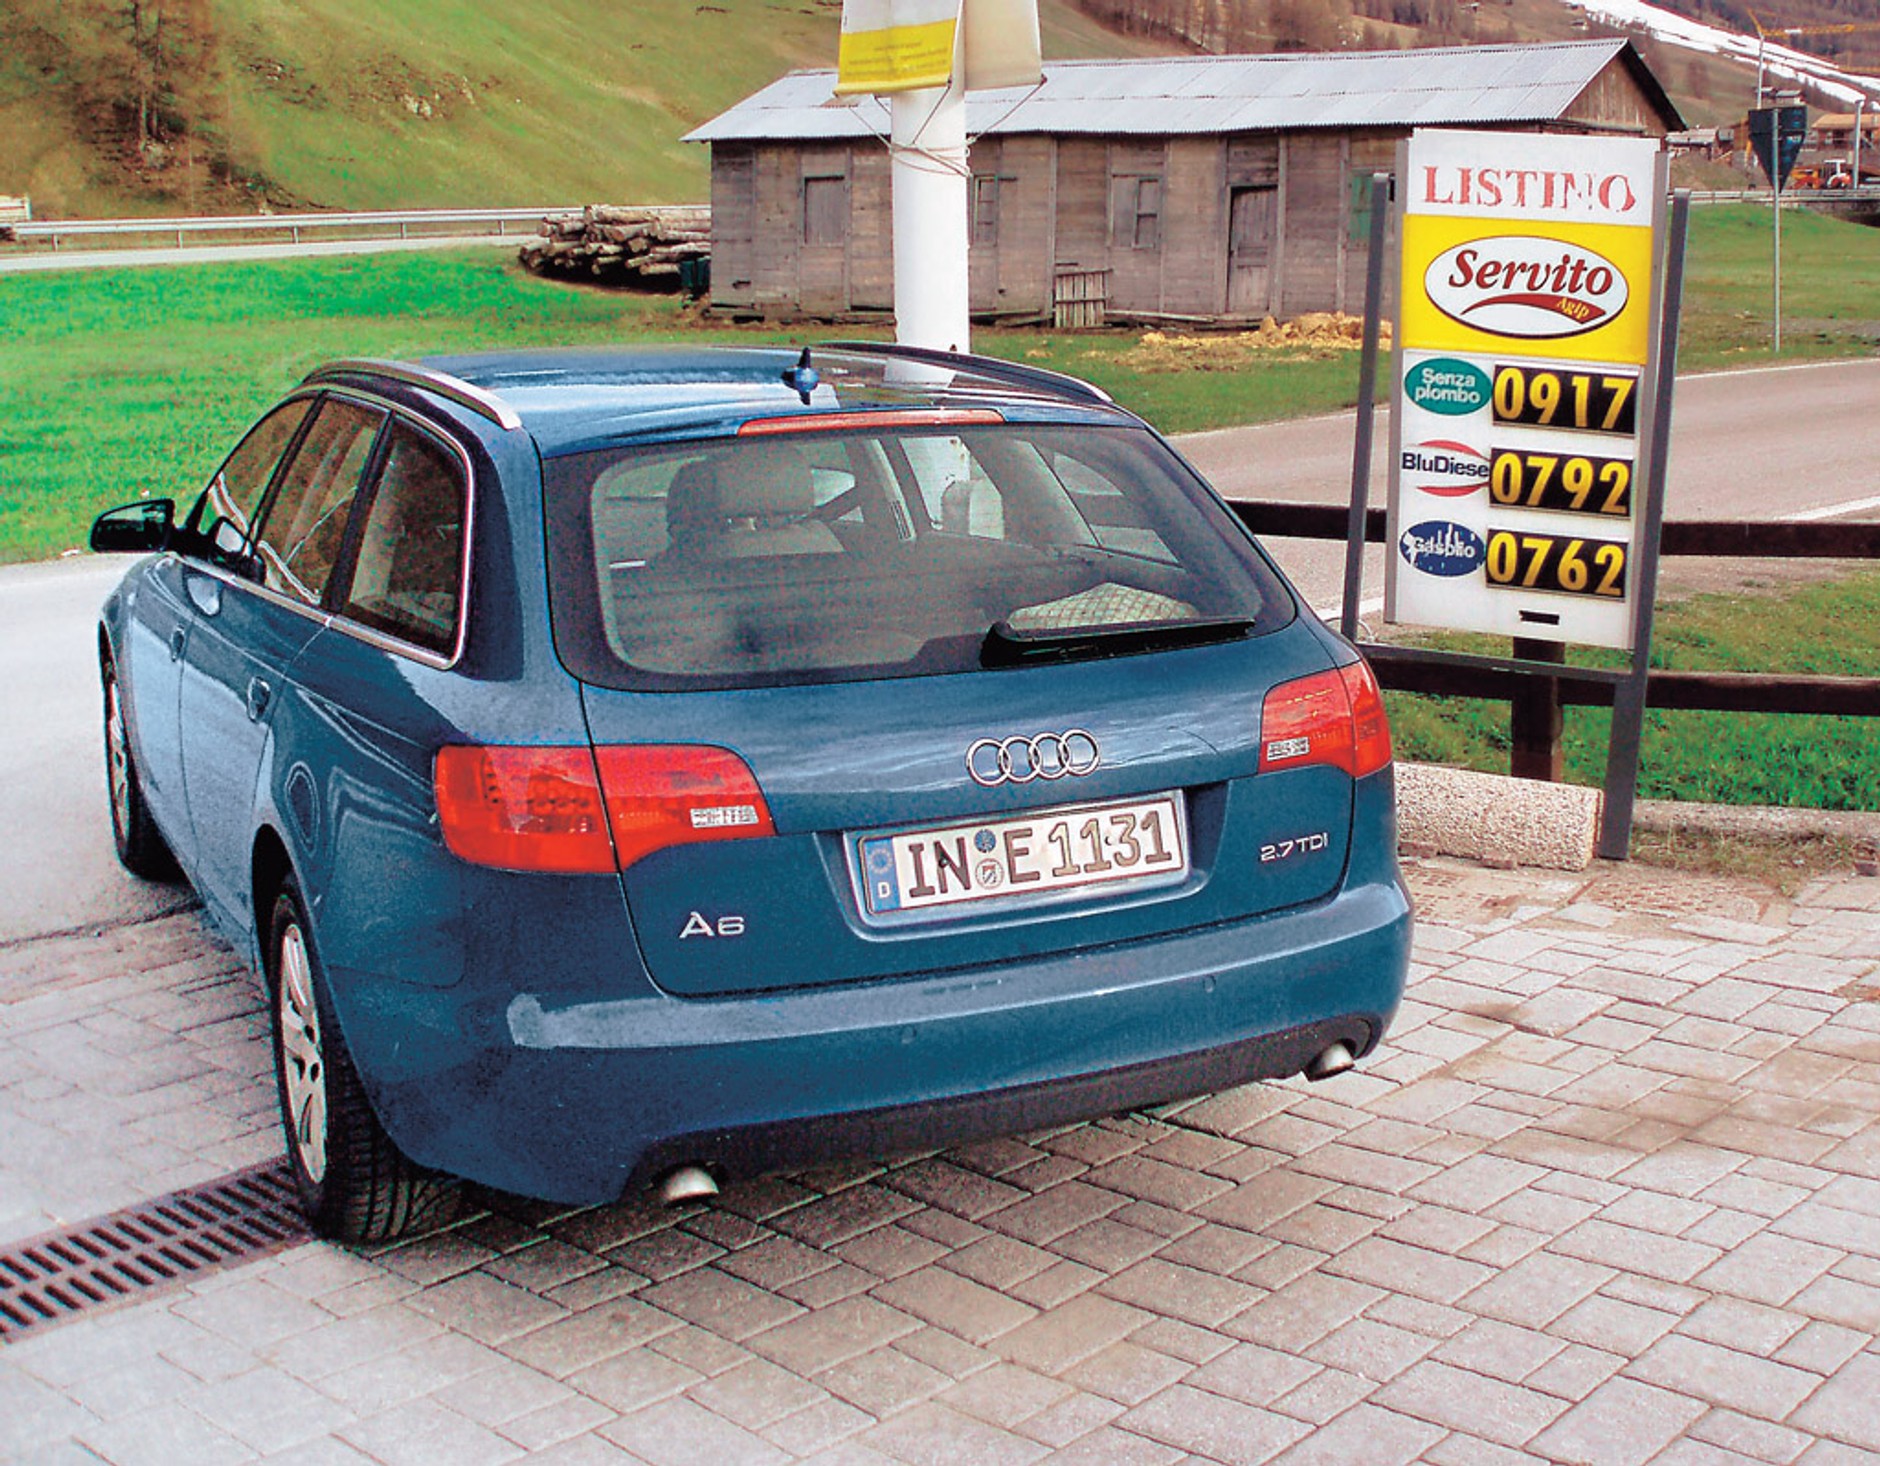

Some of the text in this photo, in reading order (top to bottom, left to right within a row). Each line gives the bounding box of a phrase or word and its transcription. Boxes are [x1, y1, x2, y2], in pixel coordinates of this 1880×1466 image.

[1423, 166, 1636, 212] LISTINO
[1448, 249, 1613, 295] Servito
[1415, 384, 1481, 403] plombo
[1421, 367, 1476, 387] Senza
[1494, 367, 1635, 429] 0917
[1402, 452, 1489, 478] BluDiese
[1490, 452, 1630, 514] 0792
[1486, 532, 1625, 596] 0762
[679, 911, 745, 938] A6
